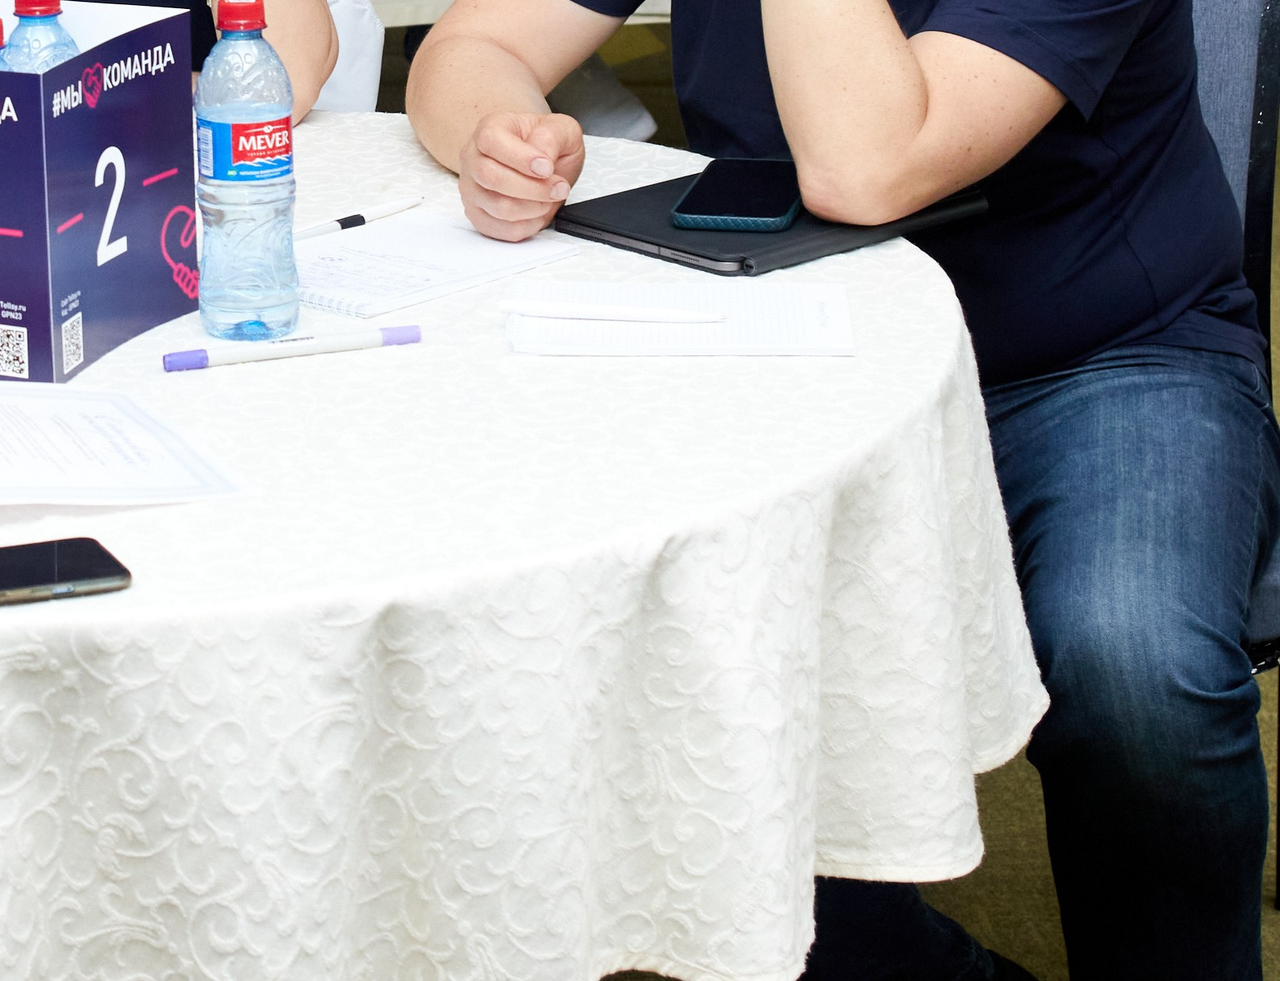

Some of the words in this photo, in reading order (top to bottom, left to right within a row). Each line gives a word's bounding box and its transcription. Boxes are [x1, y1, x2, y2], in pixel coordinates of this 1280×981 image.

[52, 80, 82, 118] #МЫ
[103, 42, 175, 91] КОМАНДА
[238, 130, 290, 151] MEVER
[93, 145, 128, 267] 2
